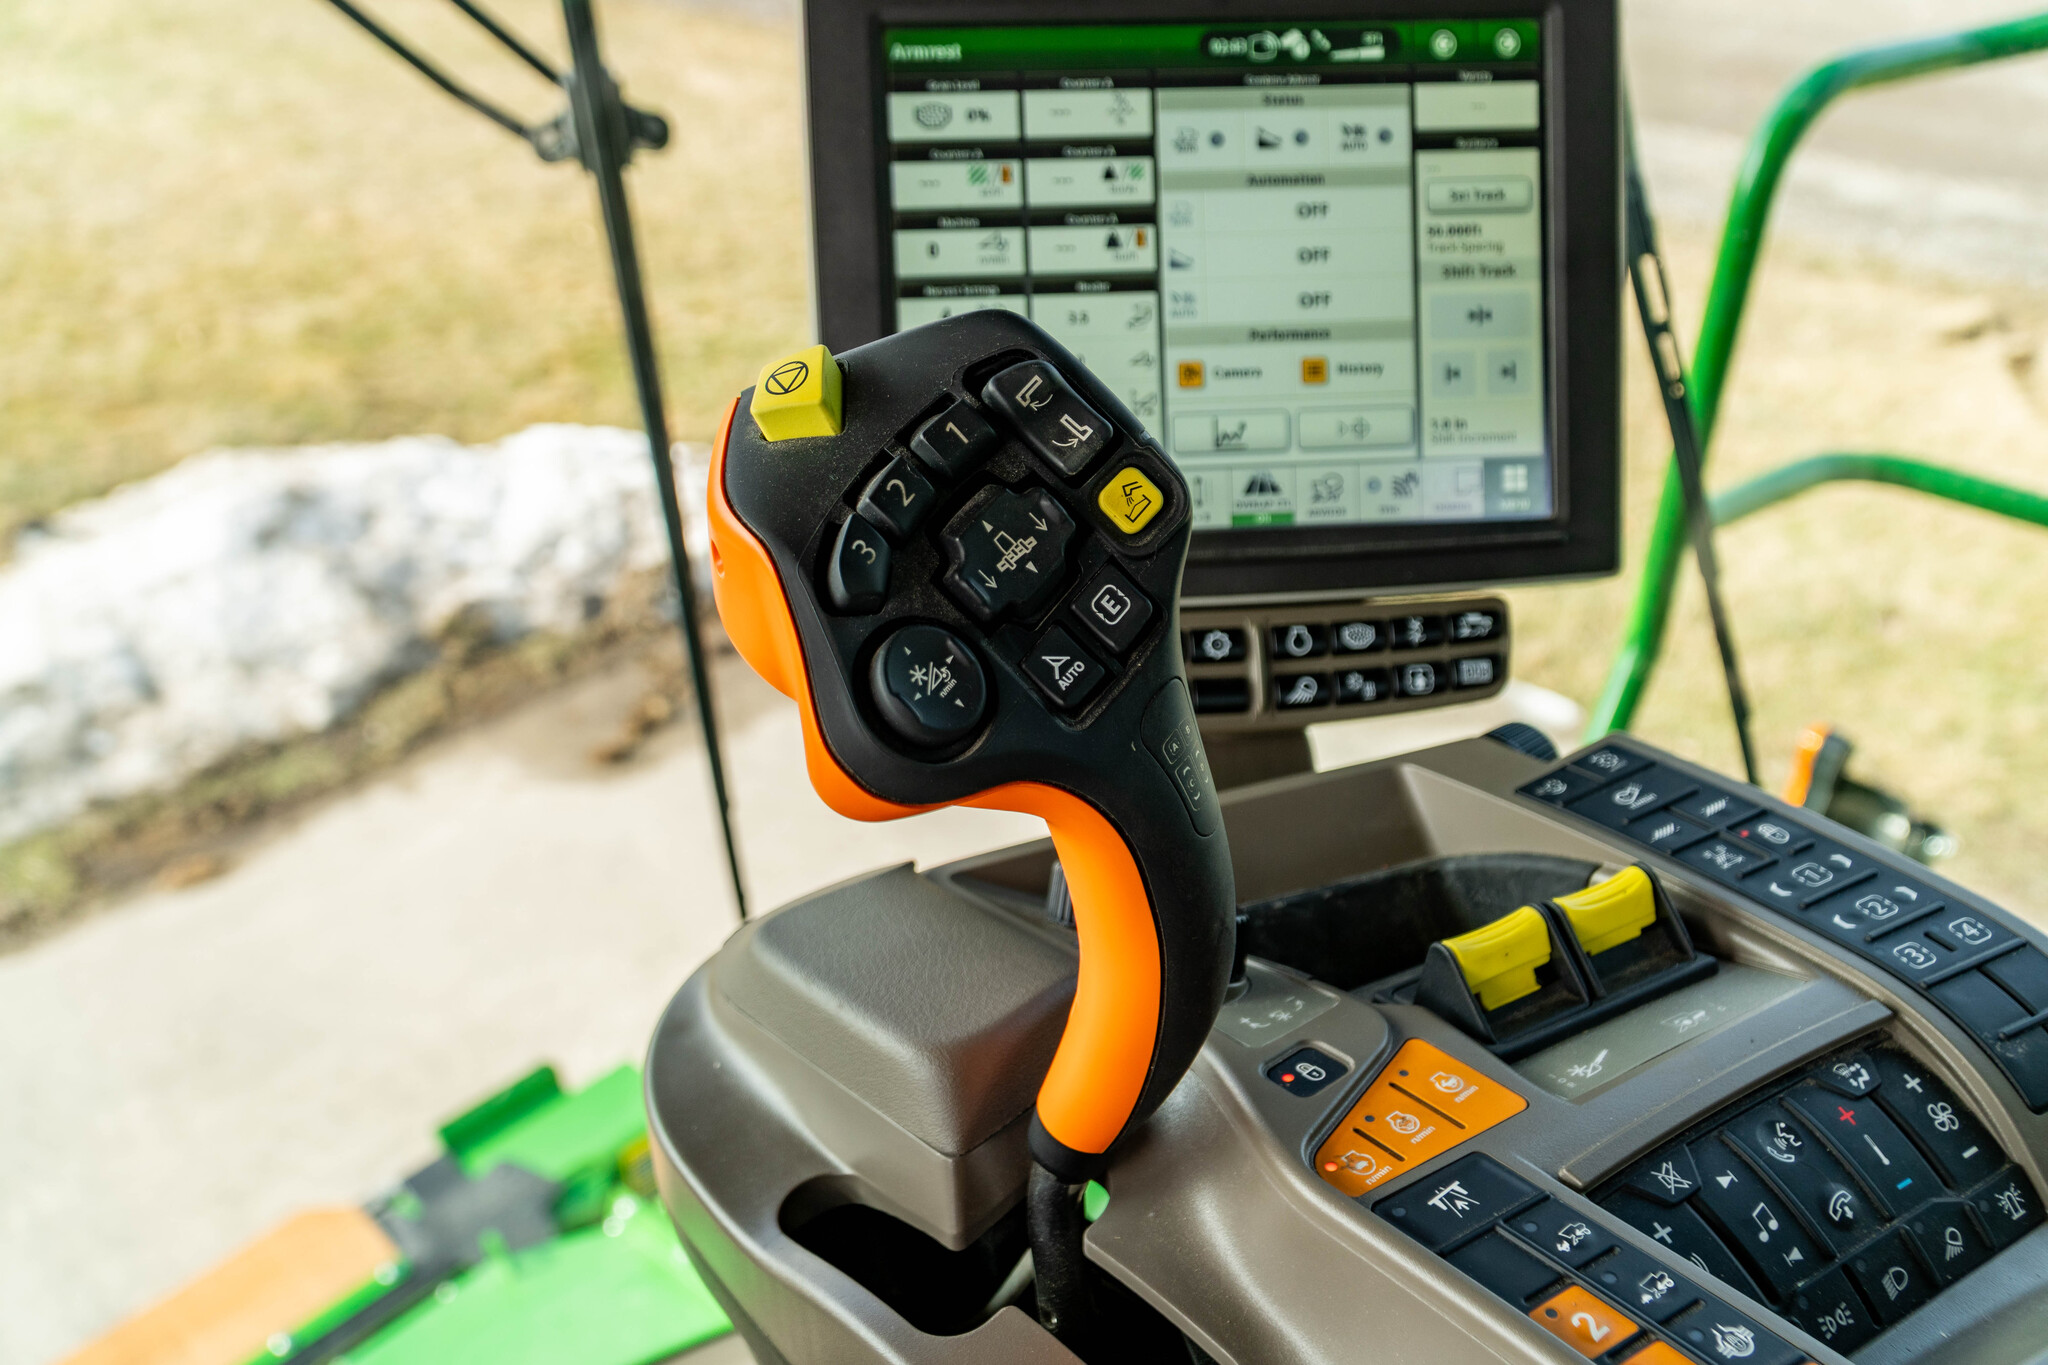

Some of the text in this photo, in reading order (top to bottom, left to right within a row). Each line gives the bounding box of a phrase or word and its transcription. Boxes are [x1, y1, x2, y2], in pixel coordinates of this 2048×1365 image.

[890, 43, 962, 61] Armrest
[1263, 94, 1305, 106] Status
[1246, 174, 1325, 186] Automation
[1297, 202, 1329, 218] OFF
[1298, 247, 1330, 263] OFF
[1299, 292, 1331, 308] OFF
[1248, 327, 1331, 340] Performance
[1213, 366, 1263, 379] Camera
[1336, 361, 1385, 379] History
[945, 421, 969, 444] 1
[886, 479, 916, 508] 2
[852, 539, 876, 565] 3
[1101, 594, 1121, 615] E
[1058, 661, 1085, 691] AUTO
[940, 678, 957, 698] n/min
[1804, 869, 1821, 881] 1
[1867, 901, 1888, 915] 2
[1962, 922, 1980, 937] 4
[1904, 946, 1924, 964] 3
[1454, 1085, 1479, 1103] n/min
[1410, 1125, 1436, 1144] n/min
[1365, 1165, 1392, 1185] n/min
[1571, 1312, 1611, 1342] 2
